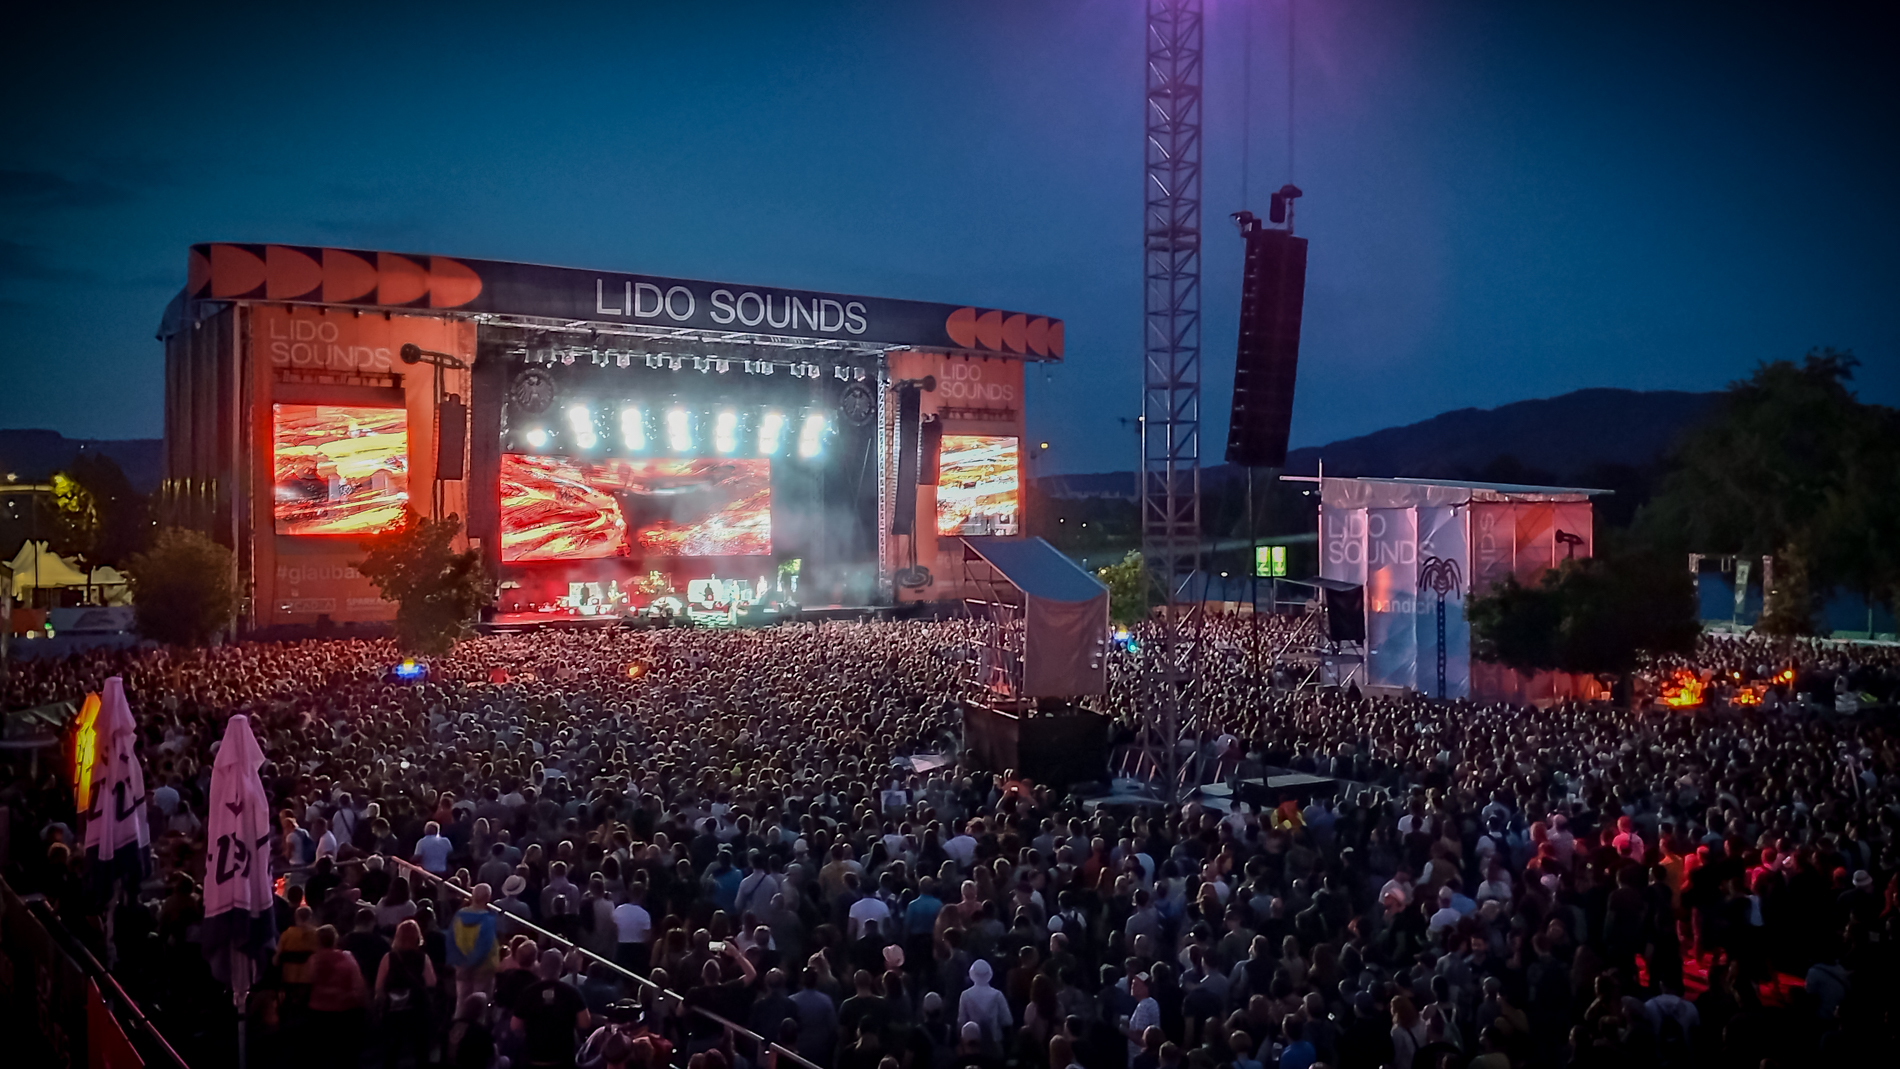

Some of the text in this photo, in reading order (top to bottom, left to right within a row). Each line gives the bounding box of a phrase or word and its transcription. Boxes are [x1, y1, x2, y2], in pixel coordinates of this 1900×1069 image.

[597, 279, 867, 334] LIDO SOUNDS
[269, 318, 339, 343] LIDO
[270, 341, 393, 369] SOUNDS
[940, 362, 981, 381] LIDO
[940, 381, 1013, 401] SOUNDS
[1328, 513, 1386, 538] LIDO
[1328, 540, 1436, 566] SOUNDS
[1371, 595, 1437, 615] bandich
